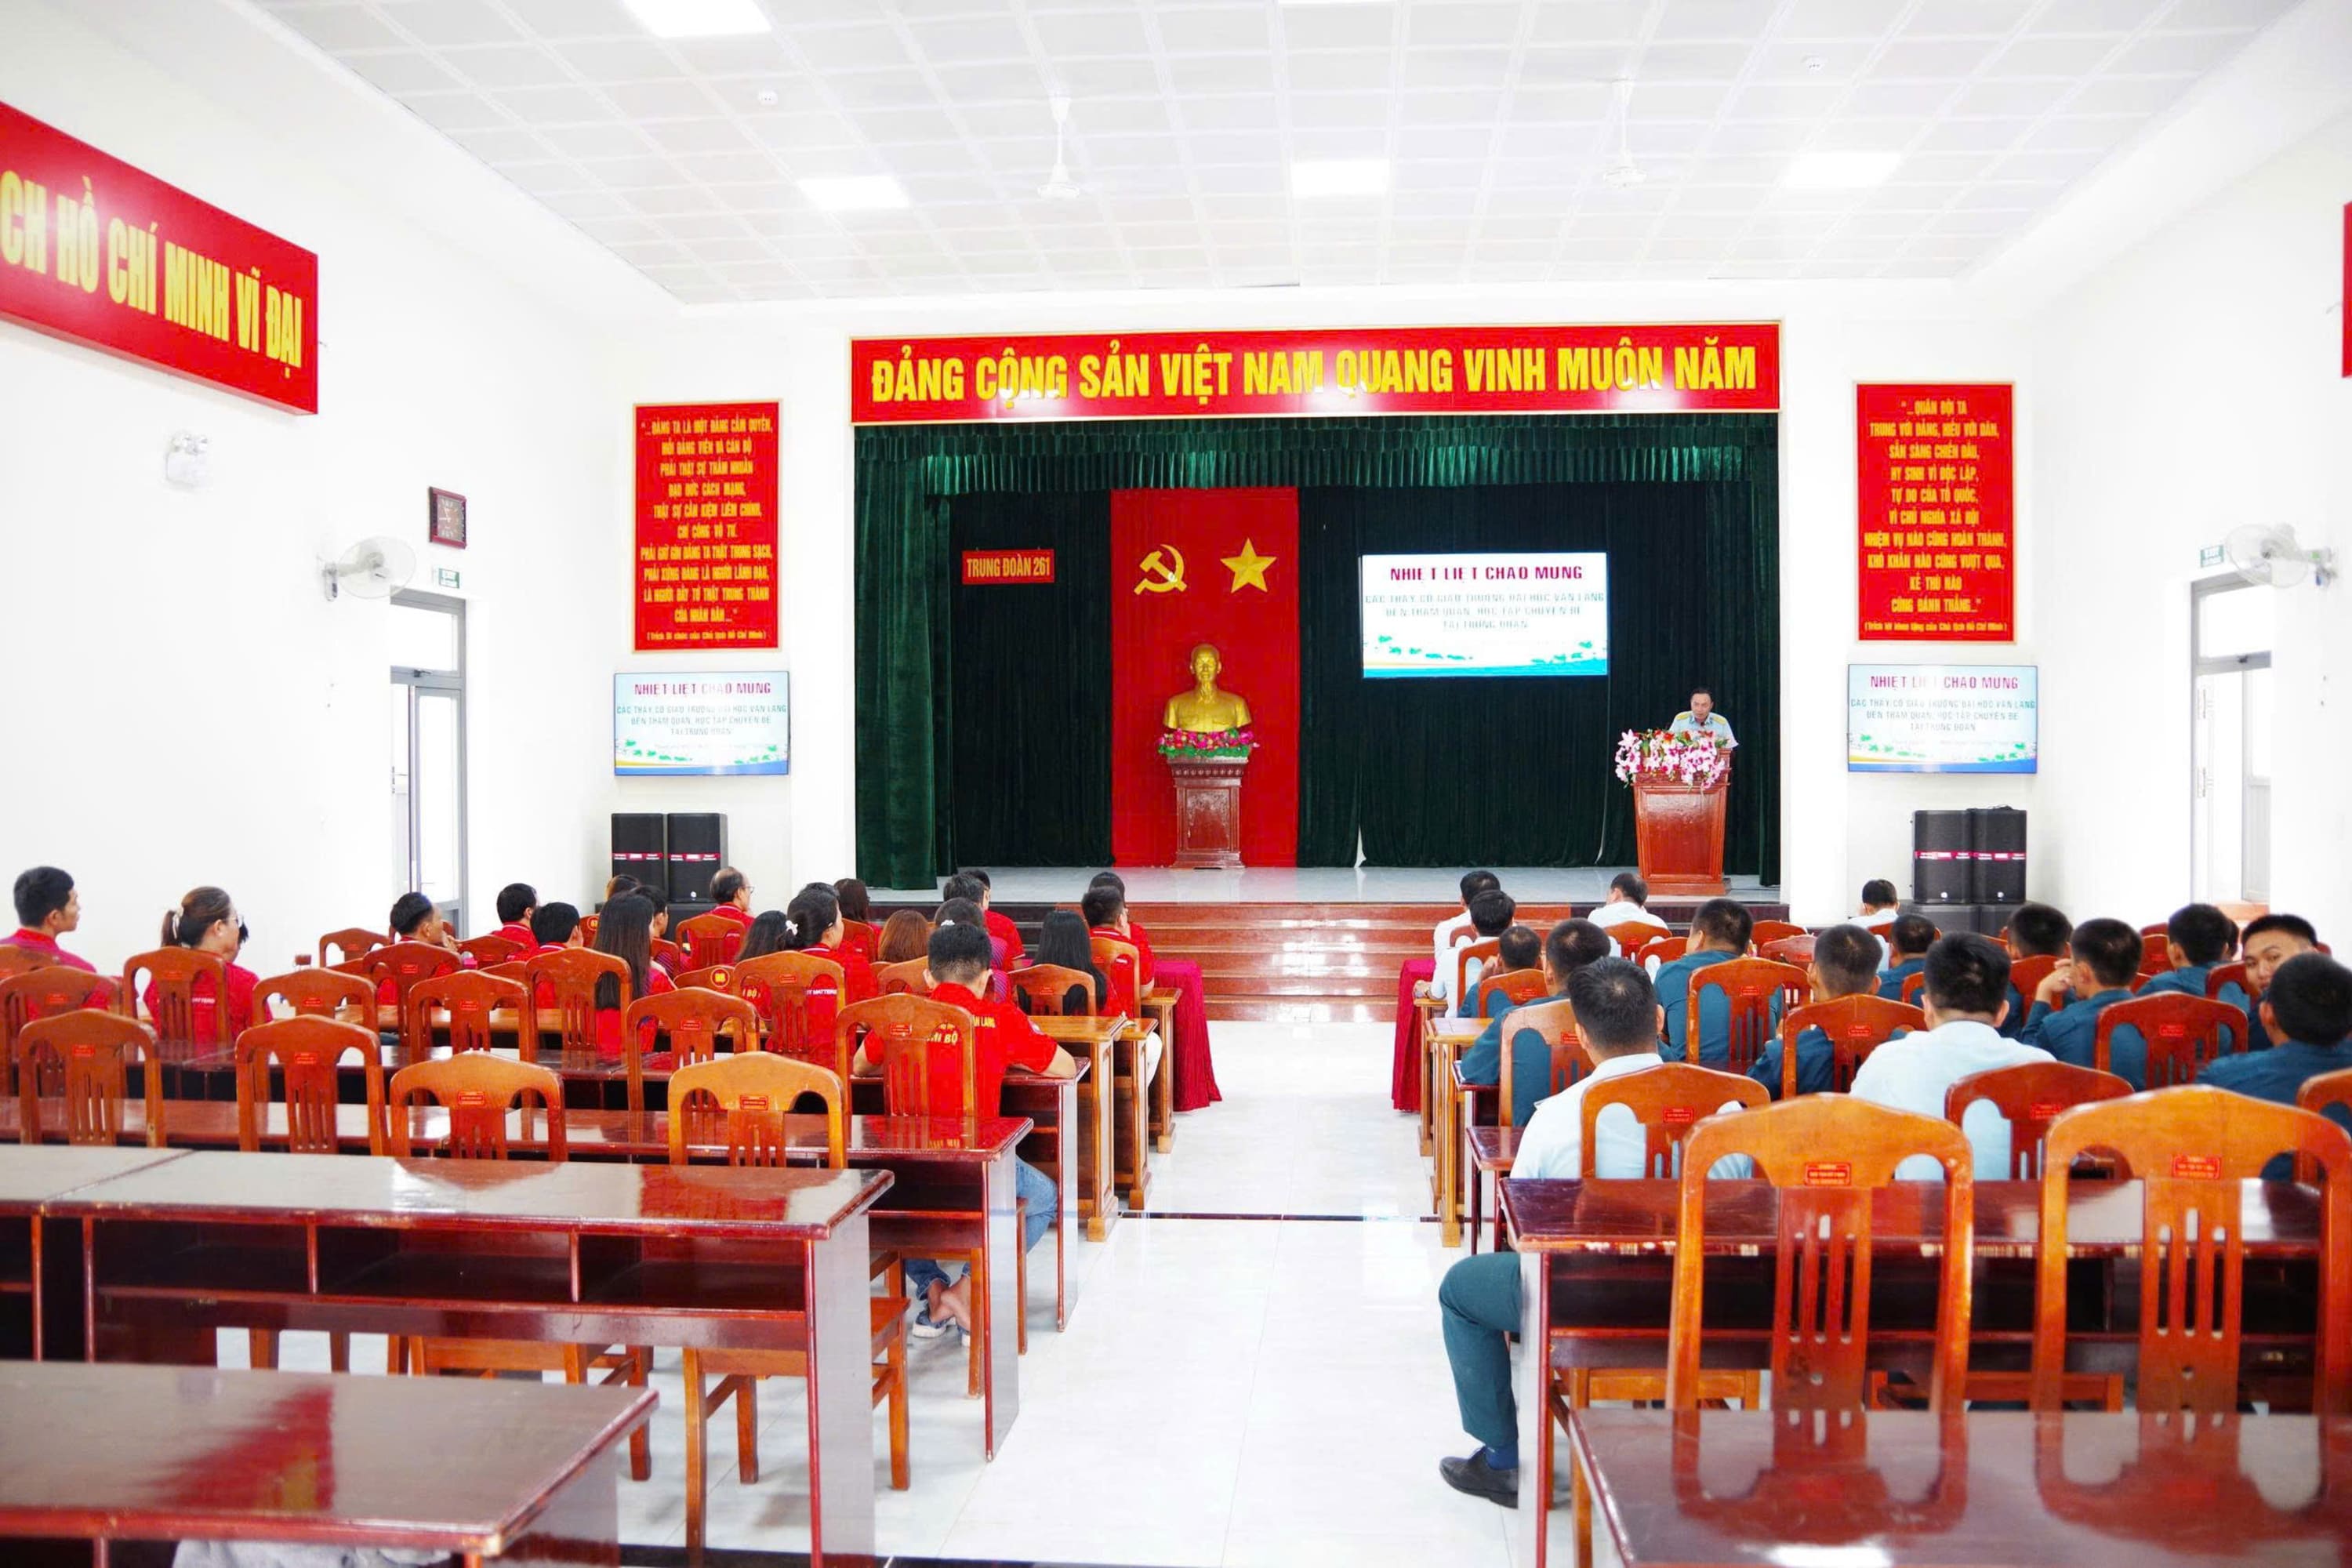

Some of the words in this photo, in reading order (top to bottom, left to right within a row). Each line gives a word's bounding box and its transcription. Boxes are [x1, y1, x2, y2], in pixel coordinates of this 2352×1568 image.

[57, 176, 100, 293] HỒ
[108, 217, 158, 315] CHÍ
[165, 241, 230, 343] MINH
[236, 267, 260, 353] VĨ
[266, 285, 302, 379] ĐẠI
[871, 345, 964, 402] ĐẢNG
[975, 347, 1068, 408] CỘNG
[1078, 341, 1149, 398] SẢN
[1161, 343, 1233, 405] VIỆT
[1243, 350, 1324, 395] NAM
[1335, 349, 1452, 397] QUANG
[1462, 346, 1546, 392] VINH
[1557, 336, 1664, 391] MUÔN
[1674, 336, 1756, 390] NĂM
[967, 557, 1000, 578] TRUNG
[1003, 553, 1031, 577] ĐOÀN
[1033, 557, 1051, 576] 261
